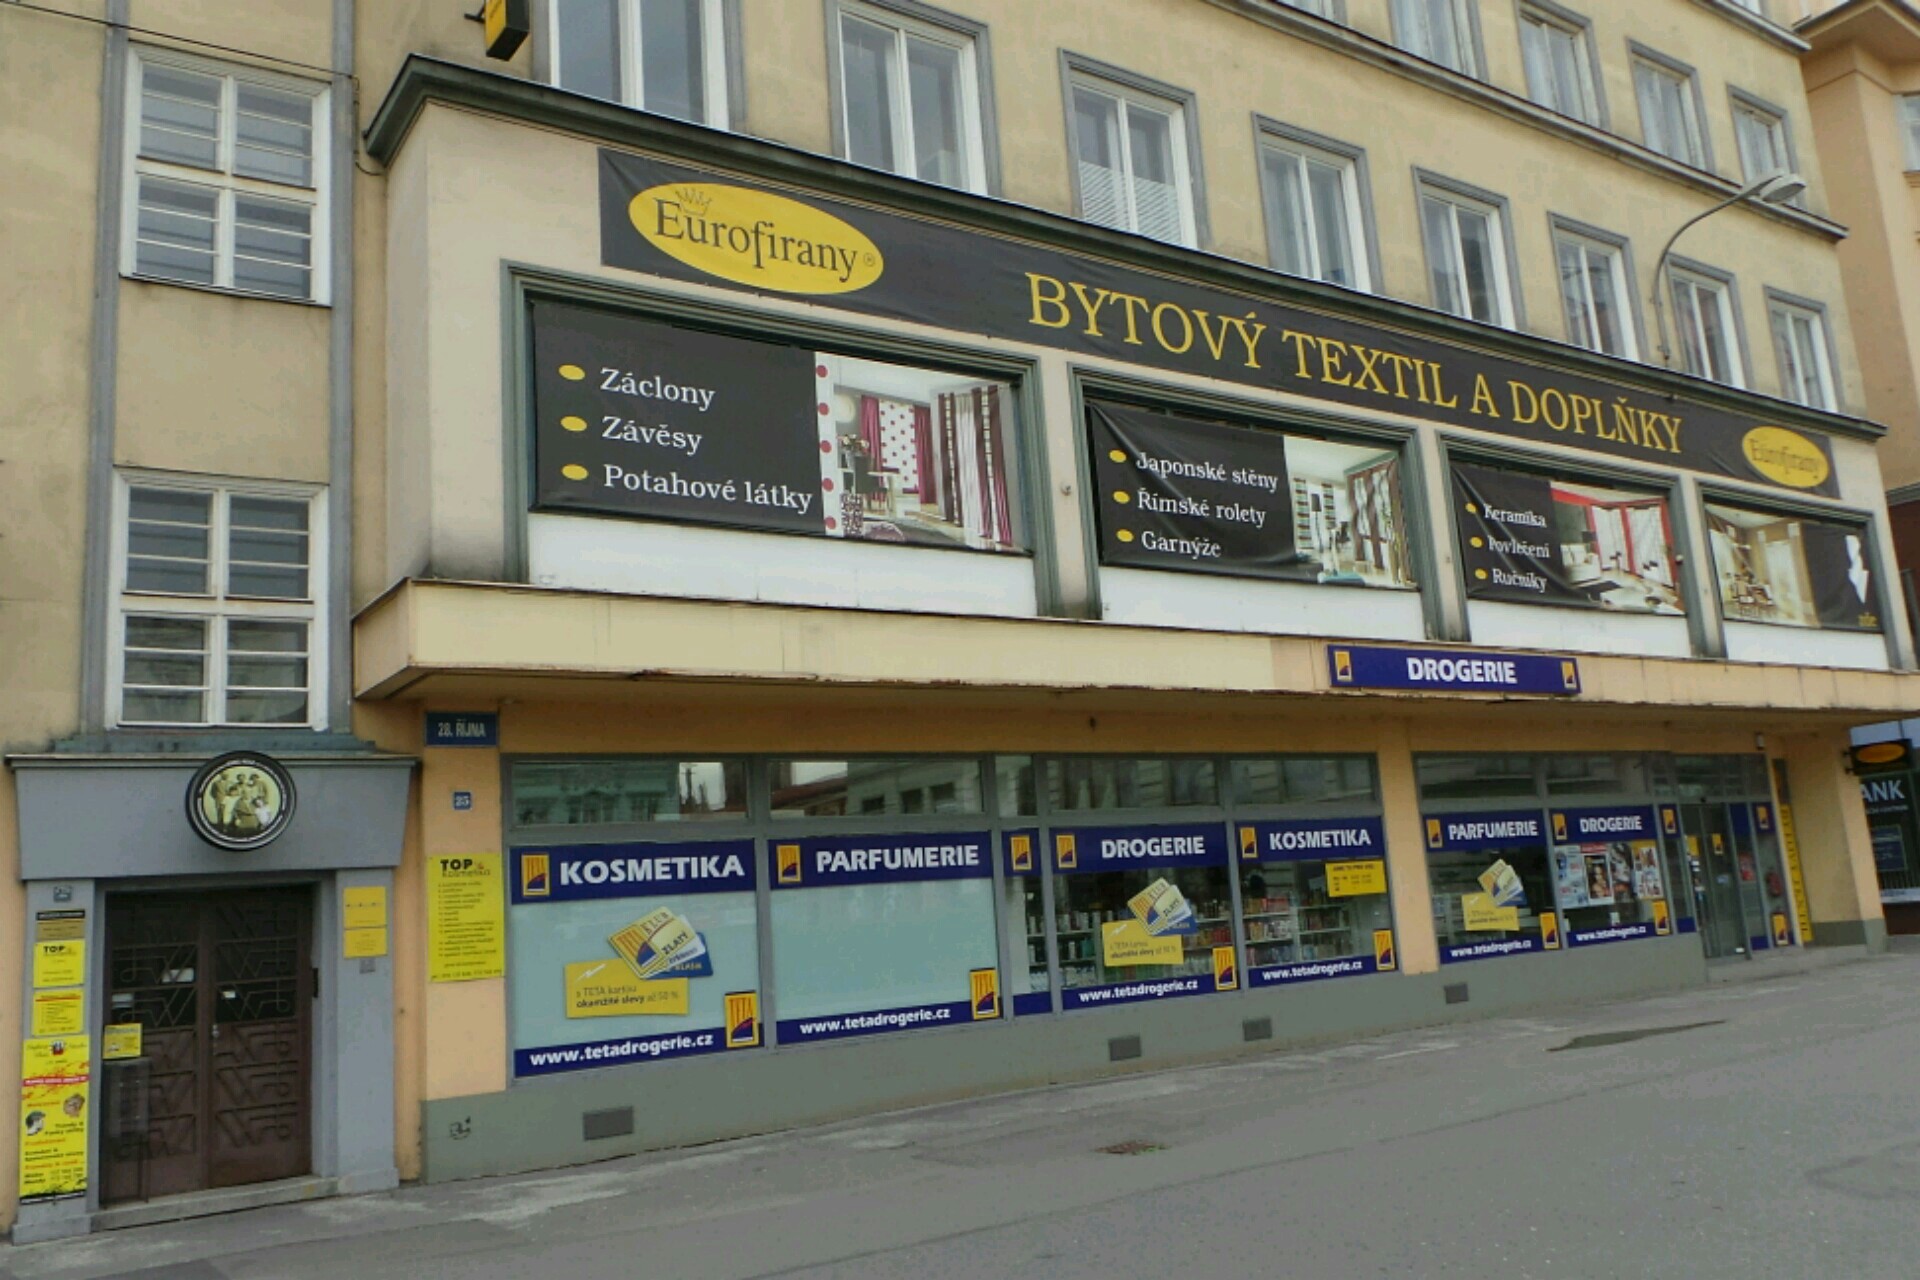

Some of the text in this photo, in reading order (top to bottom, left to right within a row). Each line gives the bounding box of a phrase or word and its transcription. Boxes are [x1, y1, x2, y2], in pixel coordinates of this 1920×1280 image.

[654, 198, 858, 283] Eurofirany
[1025, 272, 1682, 454] BYTOVÝ TEXTIL A DOPLŇKY
[600, 367, 715, 412] Záclony
[601, 415, 702, 456] Závěsy
[1136, 452, 1278, 494] Japonské stěny
[1749, 438, 1821, 480] Eurofirany
[603, 463, 813, 515] Potahové látky
[1137, 488, 1267, 529] Římské rolety
[1141, 531, 1222, 560] Garnýže
[1406, 658, 1518, 684] DROGERIE
[438, 719, 486, 737] 28. ŘÍJNA
[1448, 820, 1538, 840] PARFUMERIE
[1580, 815, 1643, 833] DROGERIE
[1101, 835, 1206, 859] DROGERIE
[1269, 829, 1371, 850] KOSMETIKA
[440, 859, 473, 871] TOP
[560, 854, 745, 886] KOSMETIKA
[816, 844, 980, 873] PARFUMERIE
[1262, 961, 1363, 980] www.tetadrogerie.cz
[1079, 980, 1198, 1002] www.tetadrogerie.cz
[800, 1008, 951, 1034] www.tetadrogerie.cz
[530, 1033, 713, 1066] www.tetadrogerie.cz
